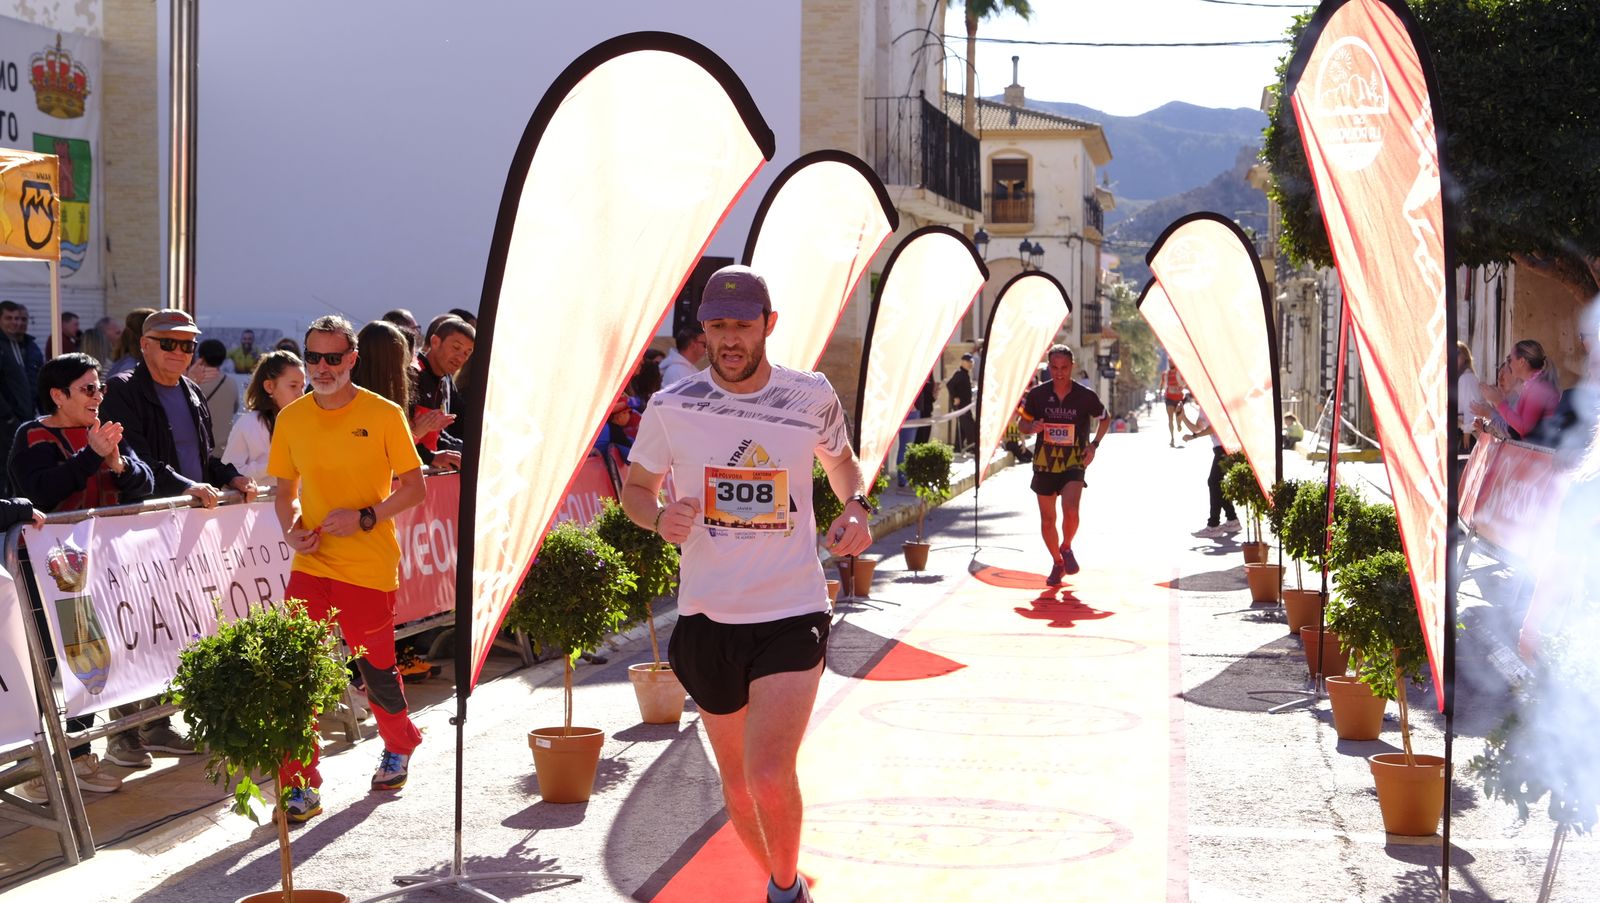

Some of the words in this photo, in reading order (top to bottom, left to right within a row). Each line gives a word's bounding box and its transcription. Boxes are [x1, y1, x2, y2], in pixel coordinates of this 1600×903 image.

[1049, 428, 1069, 437] 208
[717, 481, 773, 504] 308
[107, 545, 272, 590] AYUNTAMIENTO
